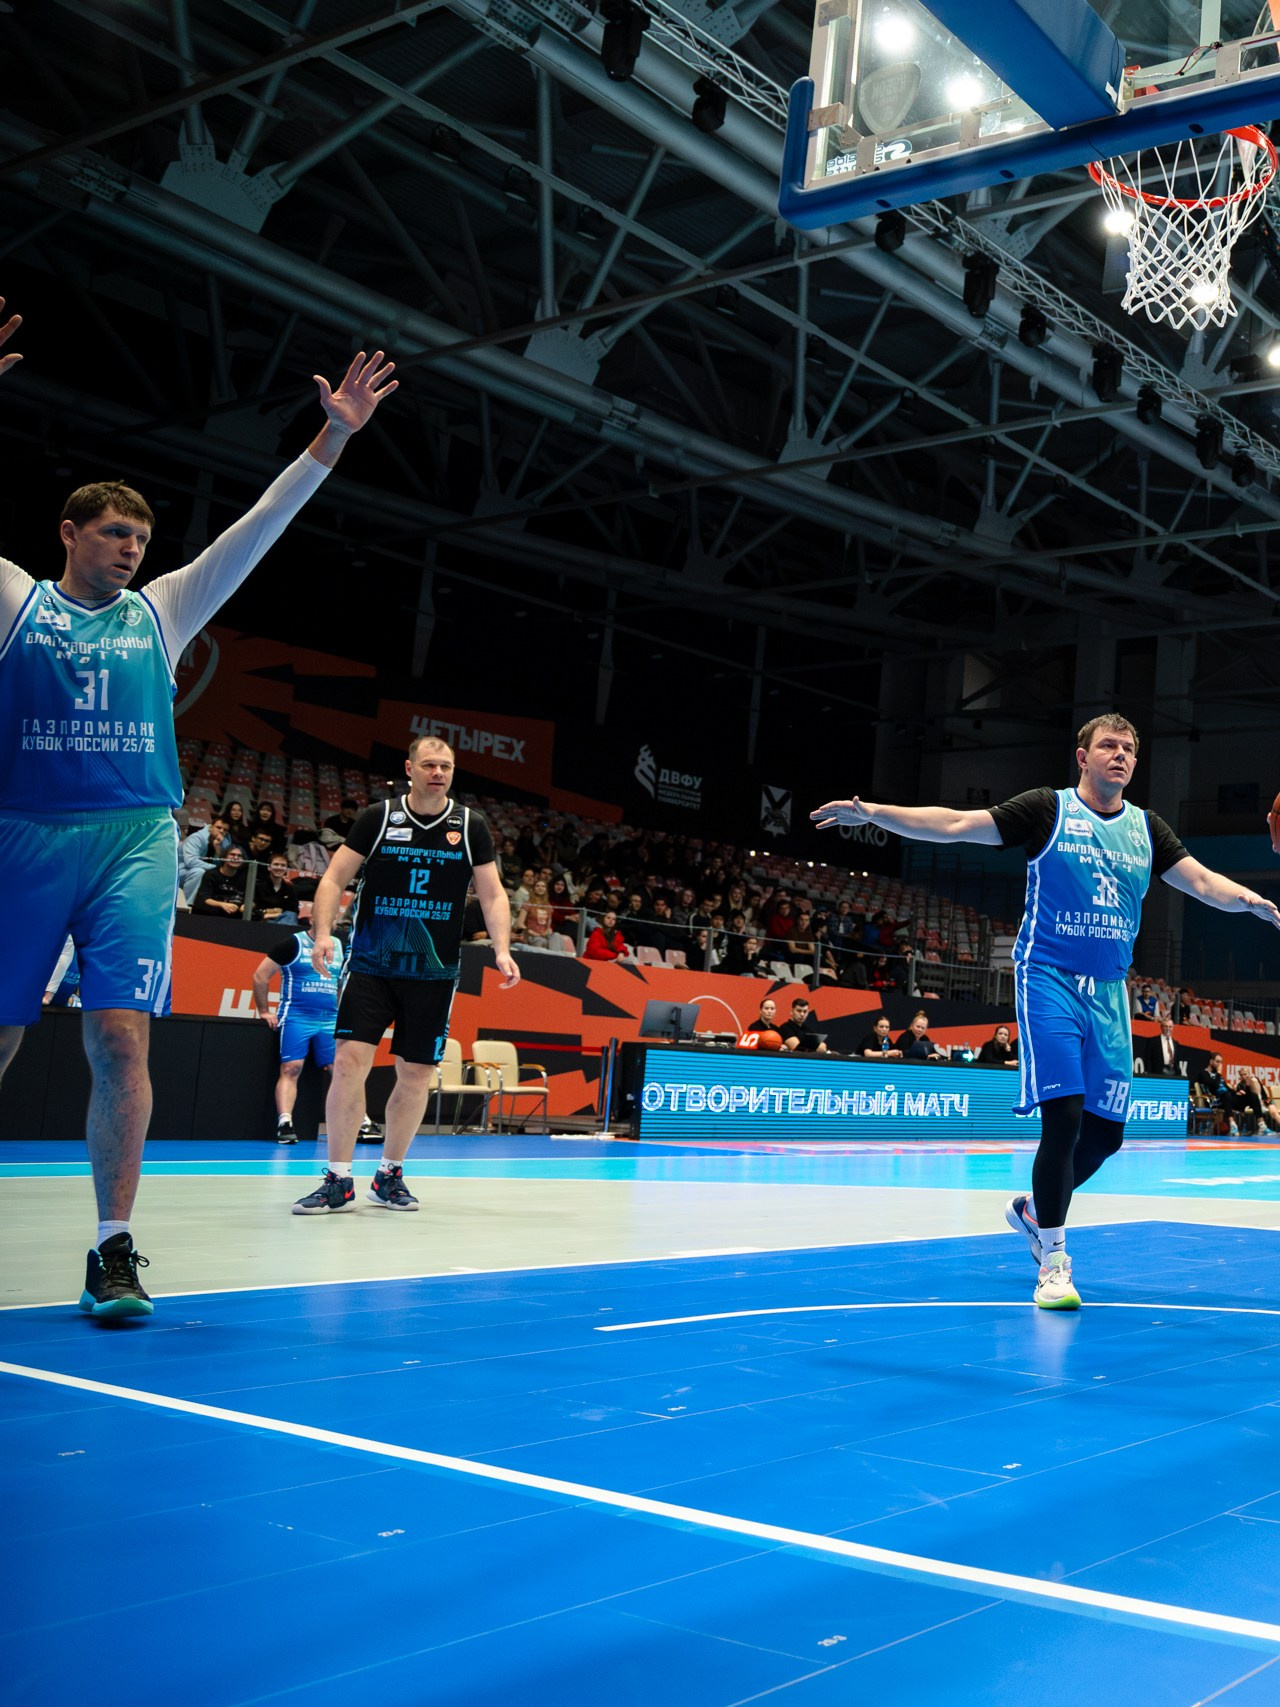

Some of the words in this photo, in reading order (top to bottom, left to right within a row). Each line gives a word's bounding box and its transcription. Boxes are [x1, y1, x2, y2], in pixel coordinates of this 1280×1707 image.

[75, 669, 109, 711] 31
[23, 719, 154, 736] ГАЗПРОМБАНК
[22, 736, 63, 750] КУБОК
[67, 737, 118, 751] РОССИИ
[122, 739, 155, 753] 25/26
[659, 769, 702, 790] ДВФУ
[381, 846, 462, 860] БЛАГОТВОРИТЕЛЬНЫЙ
[398, 856, 444, 865] МАТЧ
[409, 869, 430, 894] 12
[1092, 872, 1120, 908] 38
[375, 896, 453, 911] ГАЗПРОМБАНК
[375, 906, 398, 916] КУБОК
[400, 908, 430, 919] РОССИИ
[1056, 924, 1086, 937] КУБОК
[642, 1082, 897, 1117] ОТВОРИТЕЛЬНЫЙ
[903, 1091, 969, 1117] МАТЧ
[1097, 1078, 1130, 1115] 38
